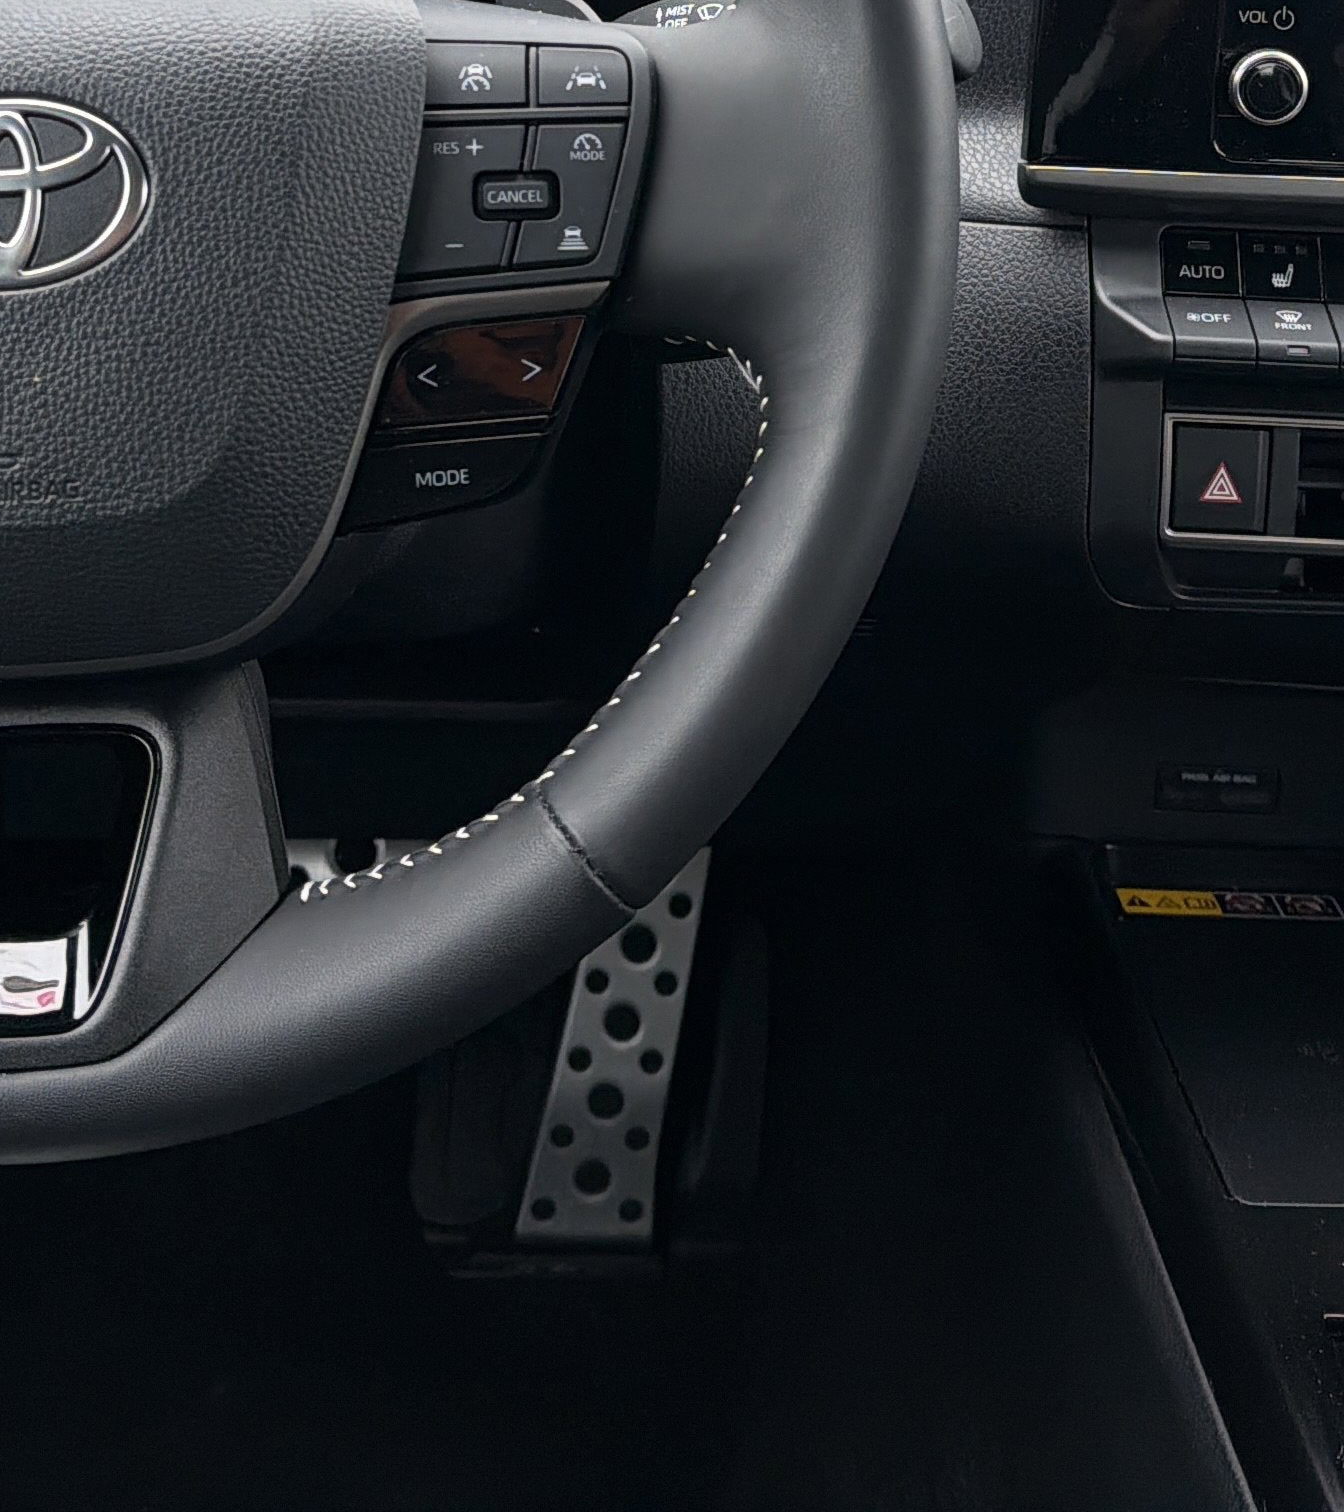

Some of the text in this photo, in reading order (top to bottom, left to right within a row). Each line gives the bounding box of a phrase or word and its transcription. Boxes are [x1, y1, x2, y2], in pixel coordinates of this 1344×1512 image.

[665, 3, 696, 17] MIST
[1238, 9, 1269, 24] VOL
[665, 17, 689, 29] OFF
[432, 141, 460, 155] RES
[569, 150, 606, 161] MODE
[487, 189, 543, 205] CANCEL
[1179, 264, 1225, 280] AUTO
[1201, 312, 1232, 324] OFF
[1274, 321, 1312, 331] FRONT
[415, 468, 471, 488] MODE
